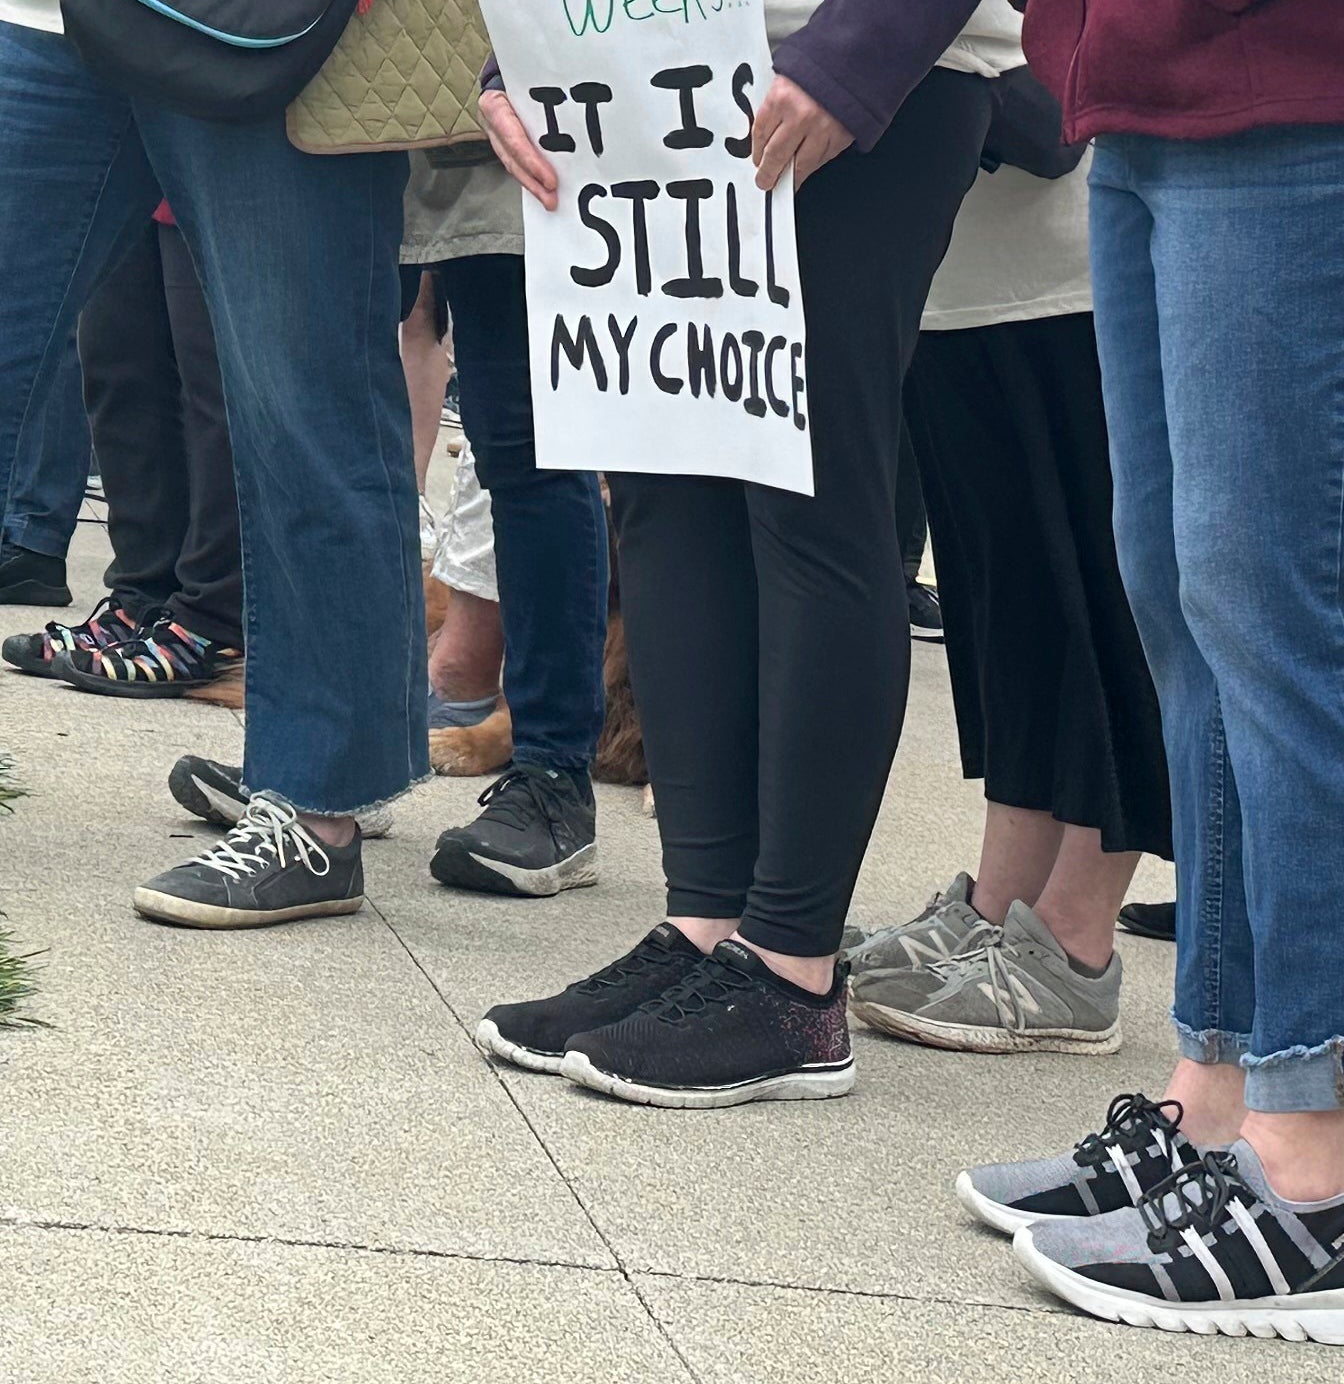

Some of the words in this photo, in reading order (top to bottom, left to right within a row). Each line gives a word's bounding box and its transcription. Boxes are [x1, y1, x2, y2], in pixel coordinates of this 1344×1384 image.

[528, 81, 614, 158] IT
[649, 62, 756, 160] IS
[569, 179, 790, 308] STILL
[550, 313, 638, 396] MY
[649, 322, 807, 432] CHOICE
